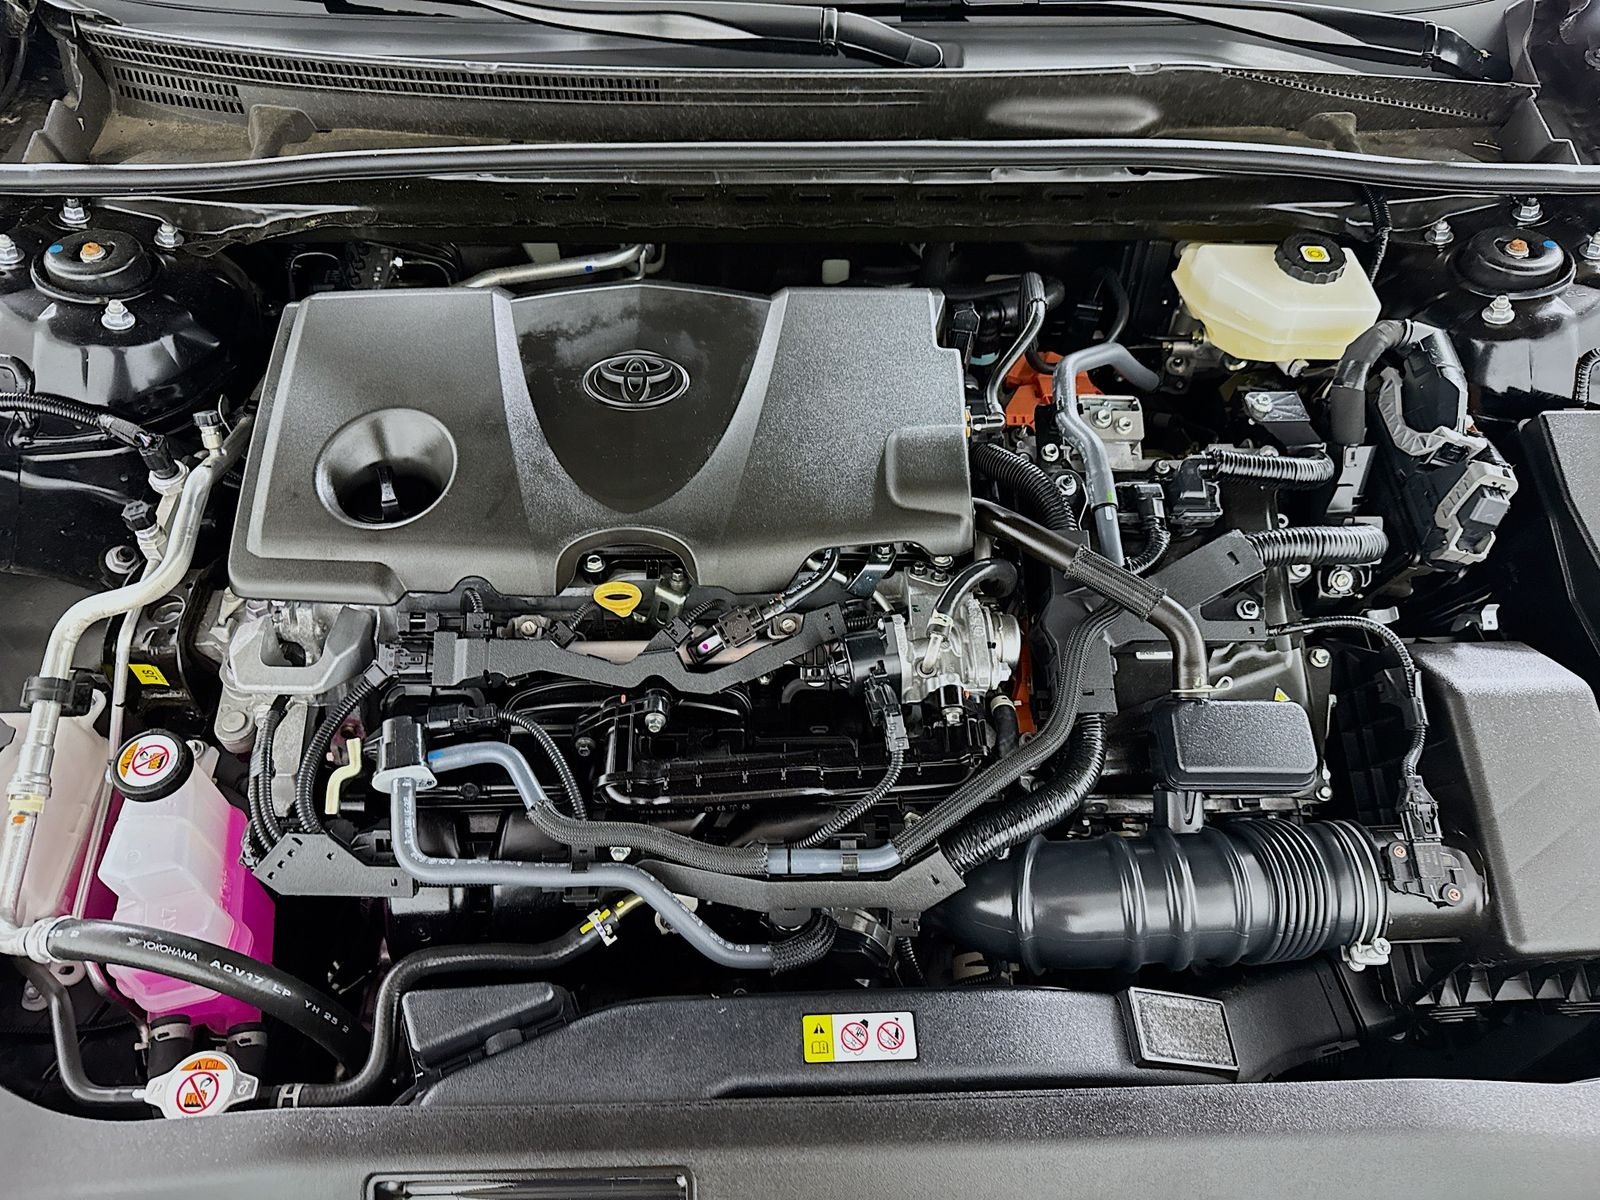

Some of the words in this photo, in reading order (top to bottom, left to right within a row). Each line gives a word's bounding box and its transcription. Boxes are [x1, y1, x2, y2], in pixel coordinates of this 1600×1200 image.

[143, 940, 198, 962] YOKOHAMA
[209, 959, 265, 984] ACV17
[272, 983, 292, 997] LP
[304, 1000, 320, 1015] YH
[323, 1011, 338, 1025] 25
